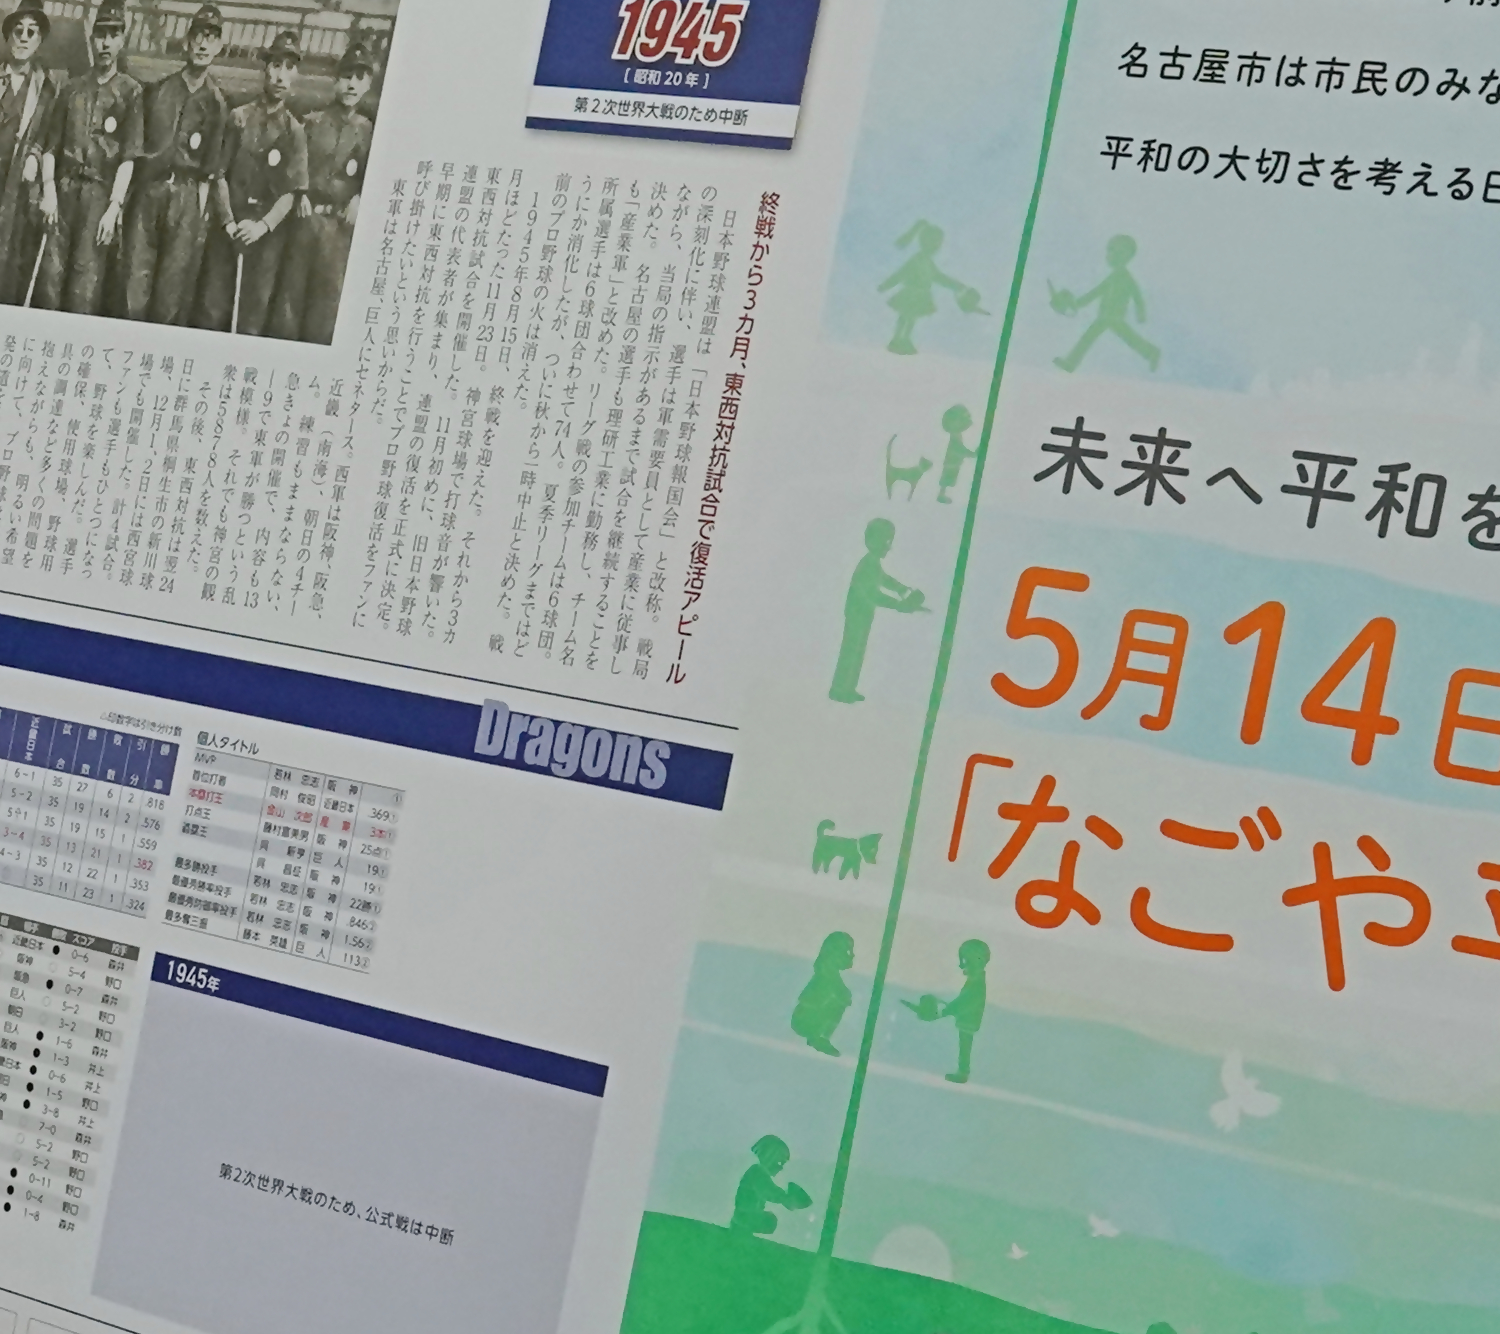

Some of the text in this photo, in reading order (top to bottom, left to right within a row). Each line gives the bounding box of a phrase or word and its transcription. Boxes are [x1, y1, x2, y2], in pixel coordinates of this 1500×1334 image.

[573, 96, 749, 127] 第2次世界大戦のため中断
[371, 160, 434, 424] 呼び掛けたいという思いからだ。
[514, 172, 574, 409] 前のプロ野球の火は消えた。
[664, 190, 781, 685] 終戦から3カ月、東西対抗試合で復活アピール
[194, 753, 217, 765] MVP
[196, 730, 259, 755] 個人タイトル
[474, 698, 672, 790] Dragons
[165, 959, 222, 993] 1945年
[218, 1162, 456, 1247] 第2次世界大戦のため、公式戦は中断
